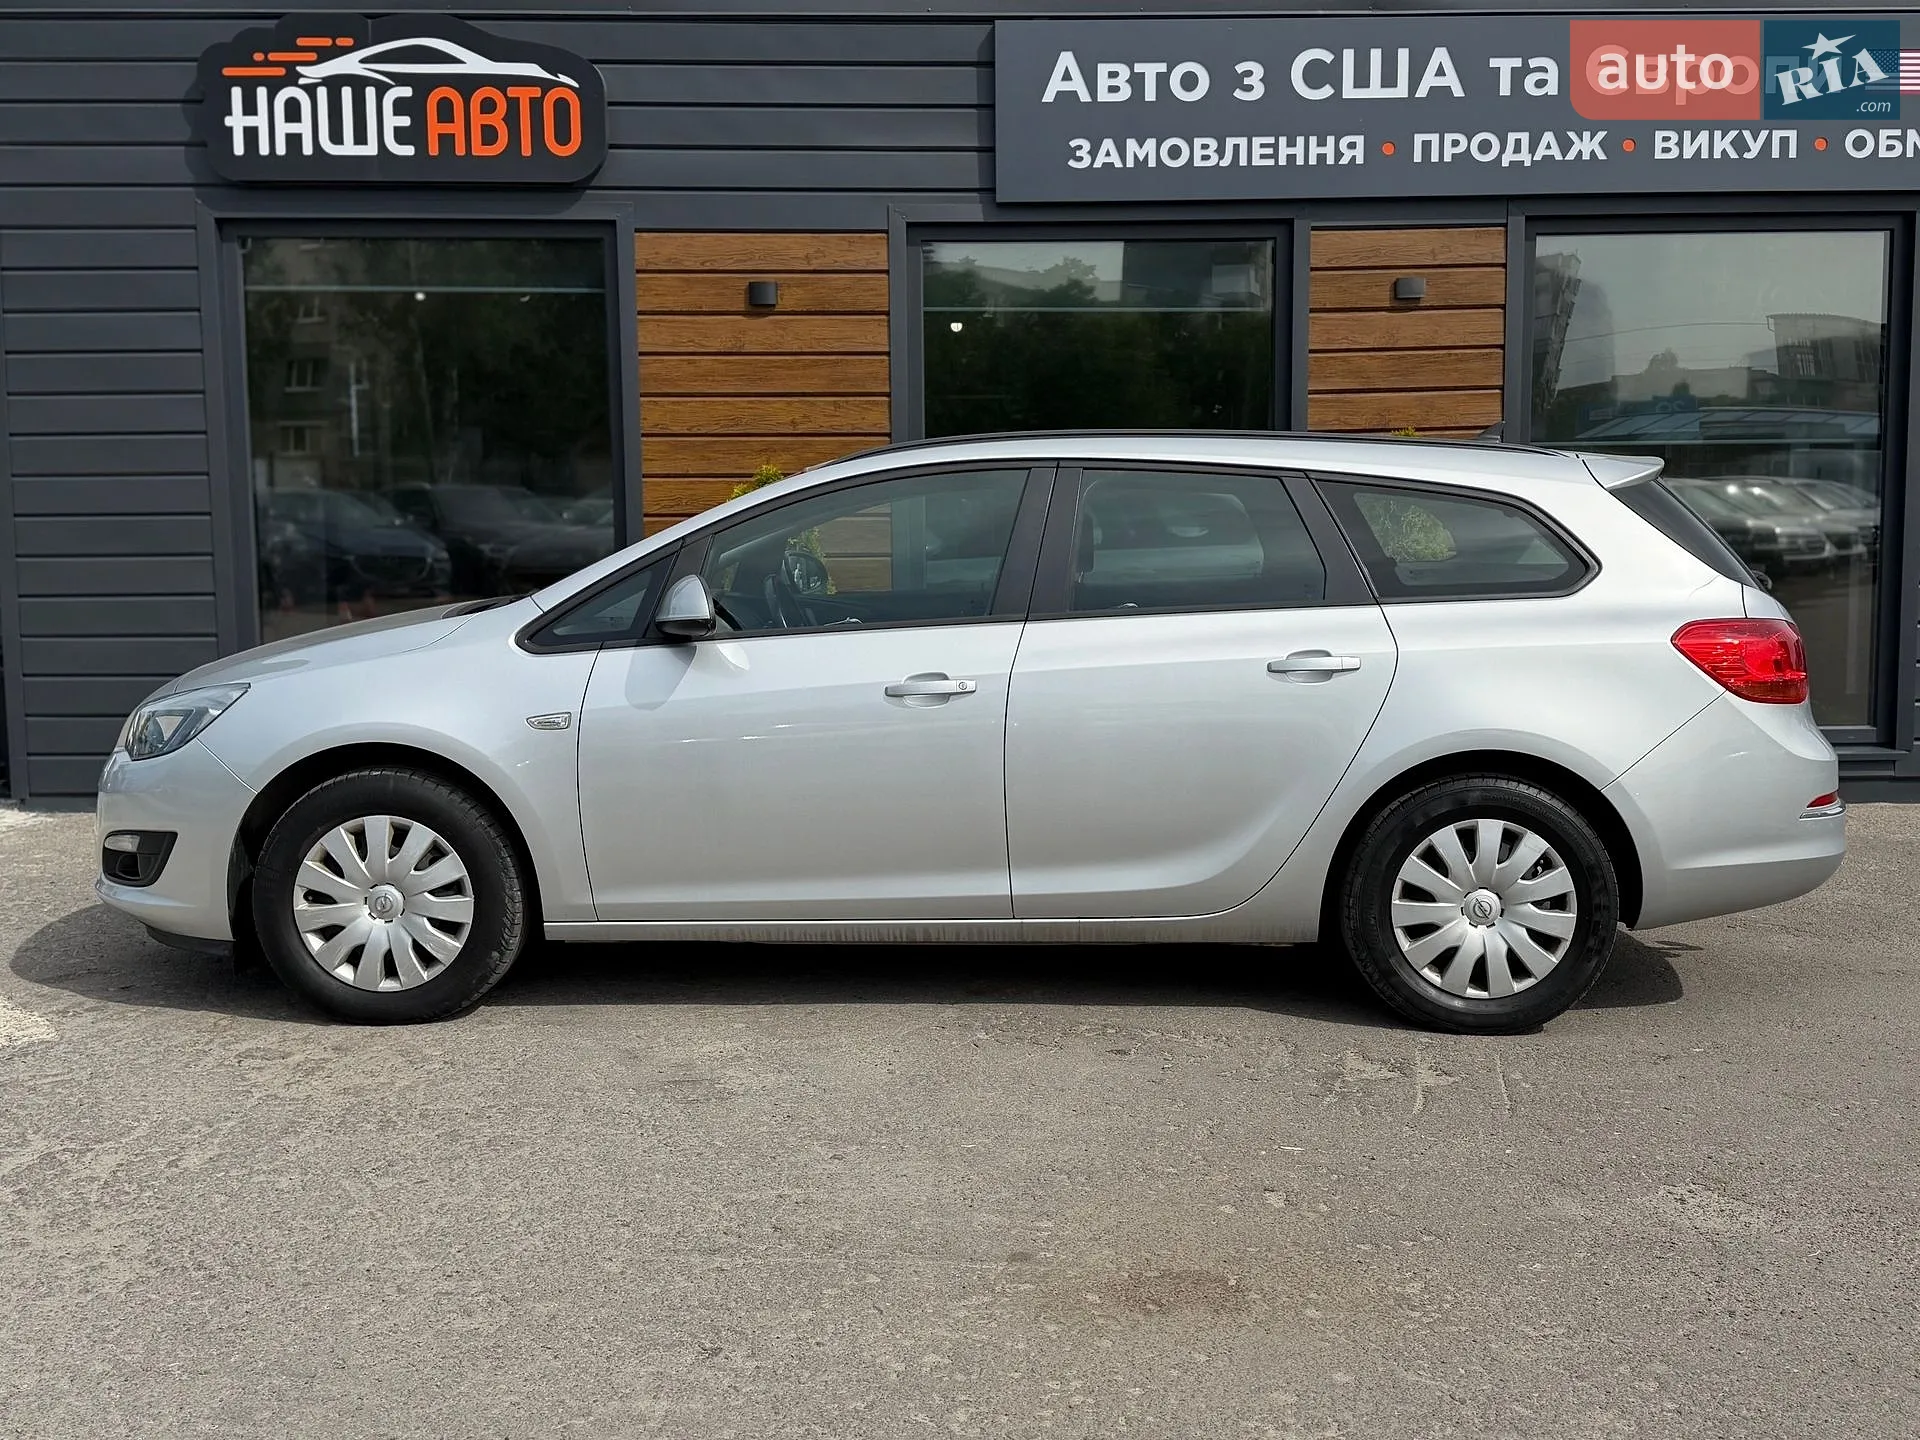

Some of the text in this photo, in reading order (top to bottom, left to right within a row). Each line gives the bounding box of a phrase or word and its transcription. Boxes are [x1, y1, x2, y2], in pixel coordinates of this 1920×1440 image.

[1042, 51, 1209, 102] Авто
[1233, 61, 1265, 101] з
[1291, 47, 1465, 100] США
[1490, 57, 1558, 96] та
[225, 86, 581, 156] НАШЕ АВТО
[1068, 135, 1364, 168] ЗАМОВЛЕННЯ
[1414, 131, 1607, 167] ПРОДАЖ
[1655, 130, 1797, 159] ВИКУП
